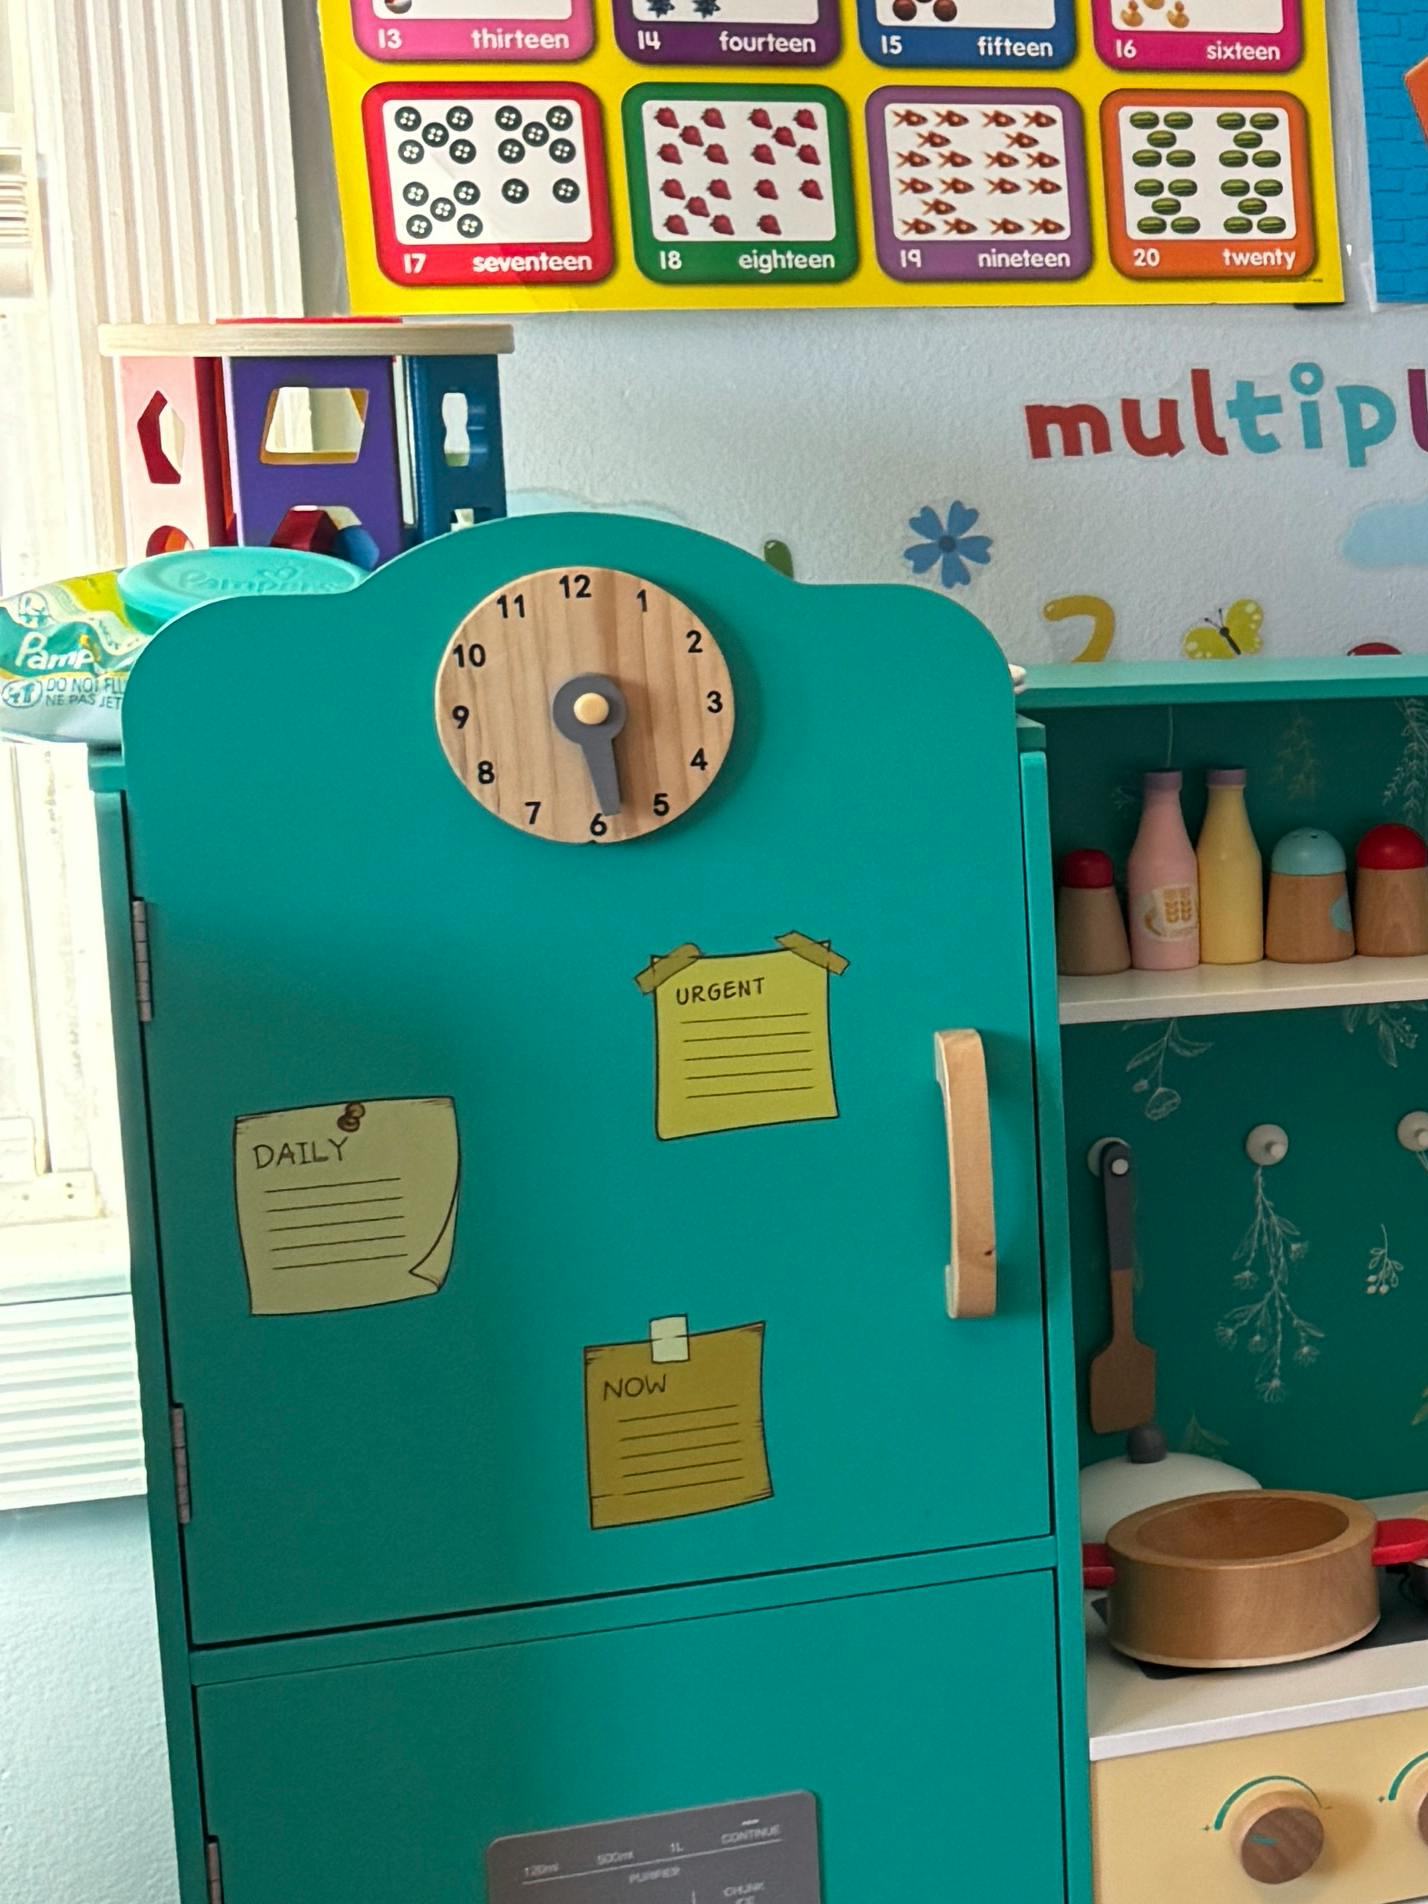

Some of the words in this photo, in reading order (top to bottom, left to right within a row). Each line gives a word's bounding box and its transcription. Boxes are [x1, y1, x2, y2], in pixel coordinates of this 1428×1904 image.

[377, 29, 403, 50] 13
[470, 28, 570, 50] thirteen
[636, 30, 661, 51] 14
[718, 33, 817, 55] fourteen
[881, 35, 903, 55] 15
[977, 36, 1054, 58] fifteen
[1115, 40, 1137, 59] 16
[1206, 41, 1281, 62] sixteen
[403, 253, 427, 274] 17
[472, 252, 593, 273] seventeen
[659, 250, 683, 271] 18
[738, 250, 836, 274] eighteen
[900, 248, 923, 268] 19
[977, 248, 1071, 269] nineteen
[1133, 248, 1161, 268] 20
[1222, 247, 1297, 271] twenty
[558, 573, 592, 599] 12
[496, 594, 526, 619] 11
[636, 589, 648, 613] 1
[685, 629, 704, 653] 2
[452, 643, 487, 668] 10
[46, 678, 67, 693] DO
[45, 693, 67, 707] NE
[69, 693, 97, 707] PAS
[706, 690, 724, 714] 3
[451, 705, 470, 729] 9
[689, 747, 709, 771] 4
[477, 760, 496, 785] 8
[524, 800, 542, 825] 7
[652, 792, 671, 817] 5
[589, 812, 608, 837] 6
[675, 976, 766, 1006] URGENT
[252, 1137, 349, 1169] DAILY
[602, 1374, 669, 1402] NOW
[720, 1824, 781, 1845] CONTINUE
